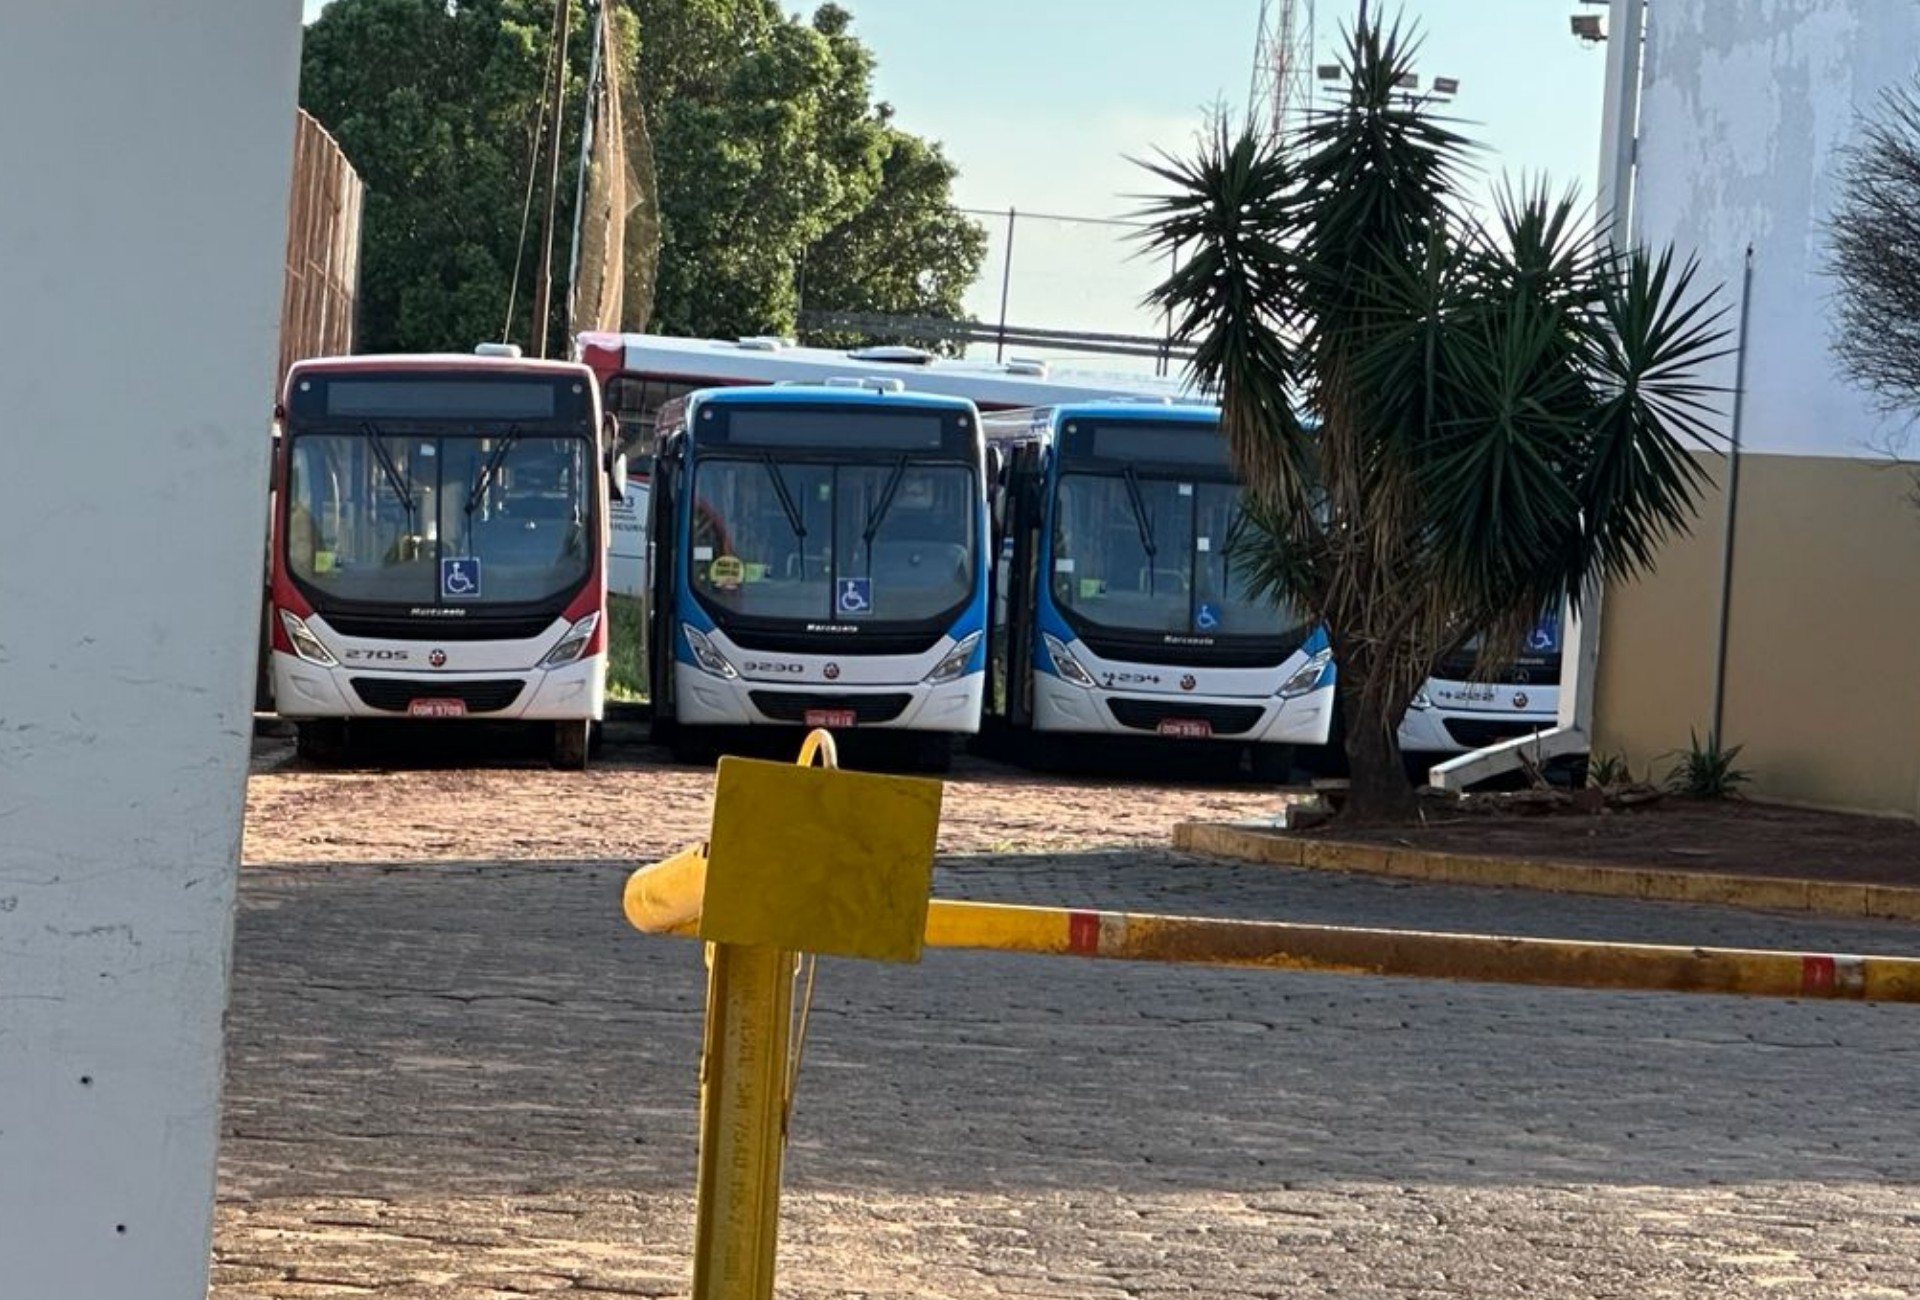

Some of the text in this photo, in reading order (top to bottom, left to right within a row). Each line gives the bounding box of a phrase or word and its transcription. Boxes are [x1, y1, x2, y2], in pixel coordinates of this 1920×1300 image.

[345, 648, 409, 661] 2705
[743, 660, 804, 673] 9230
[1102, 671, 1161, 686] 4234
